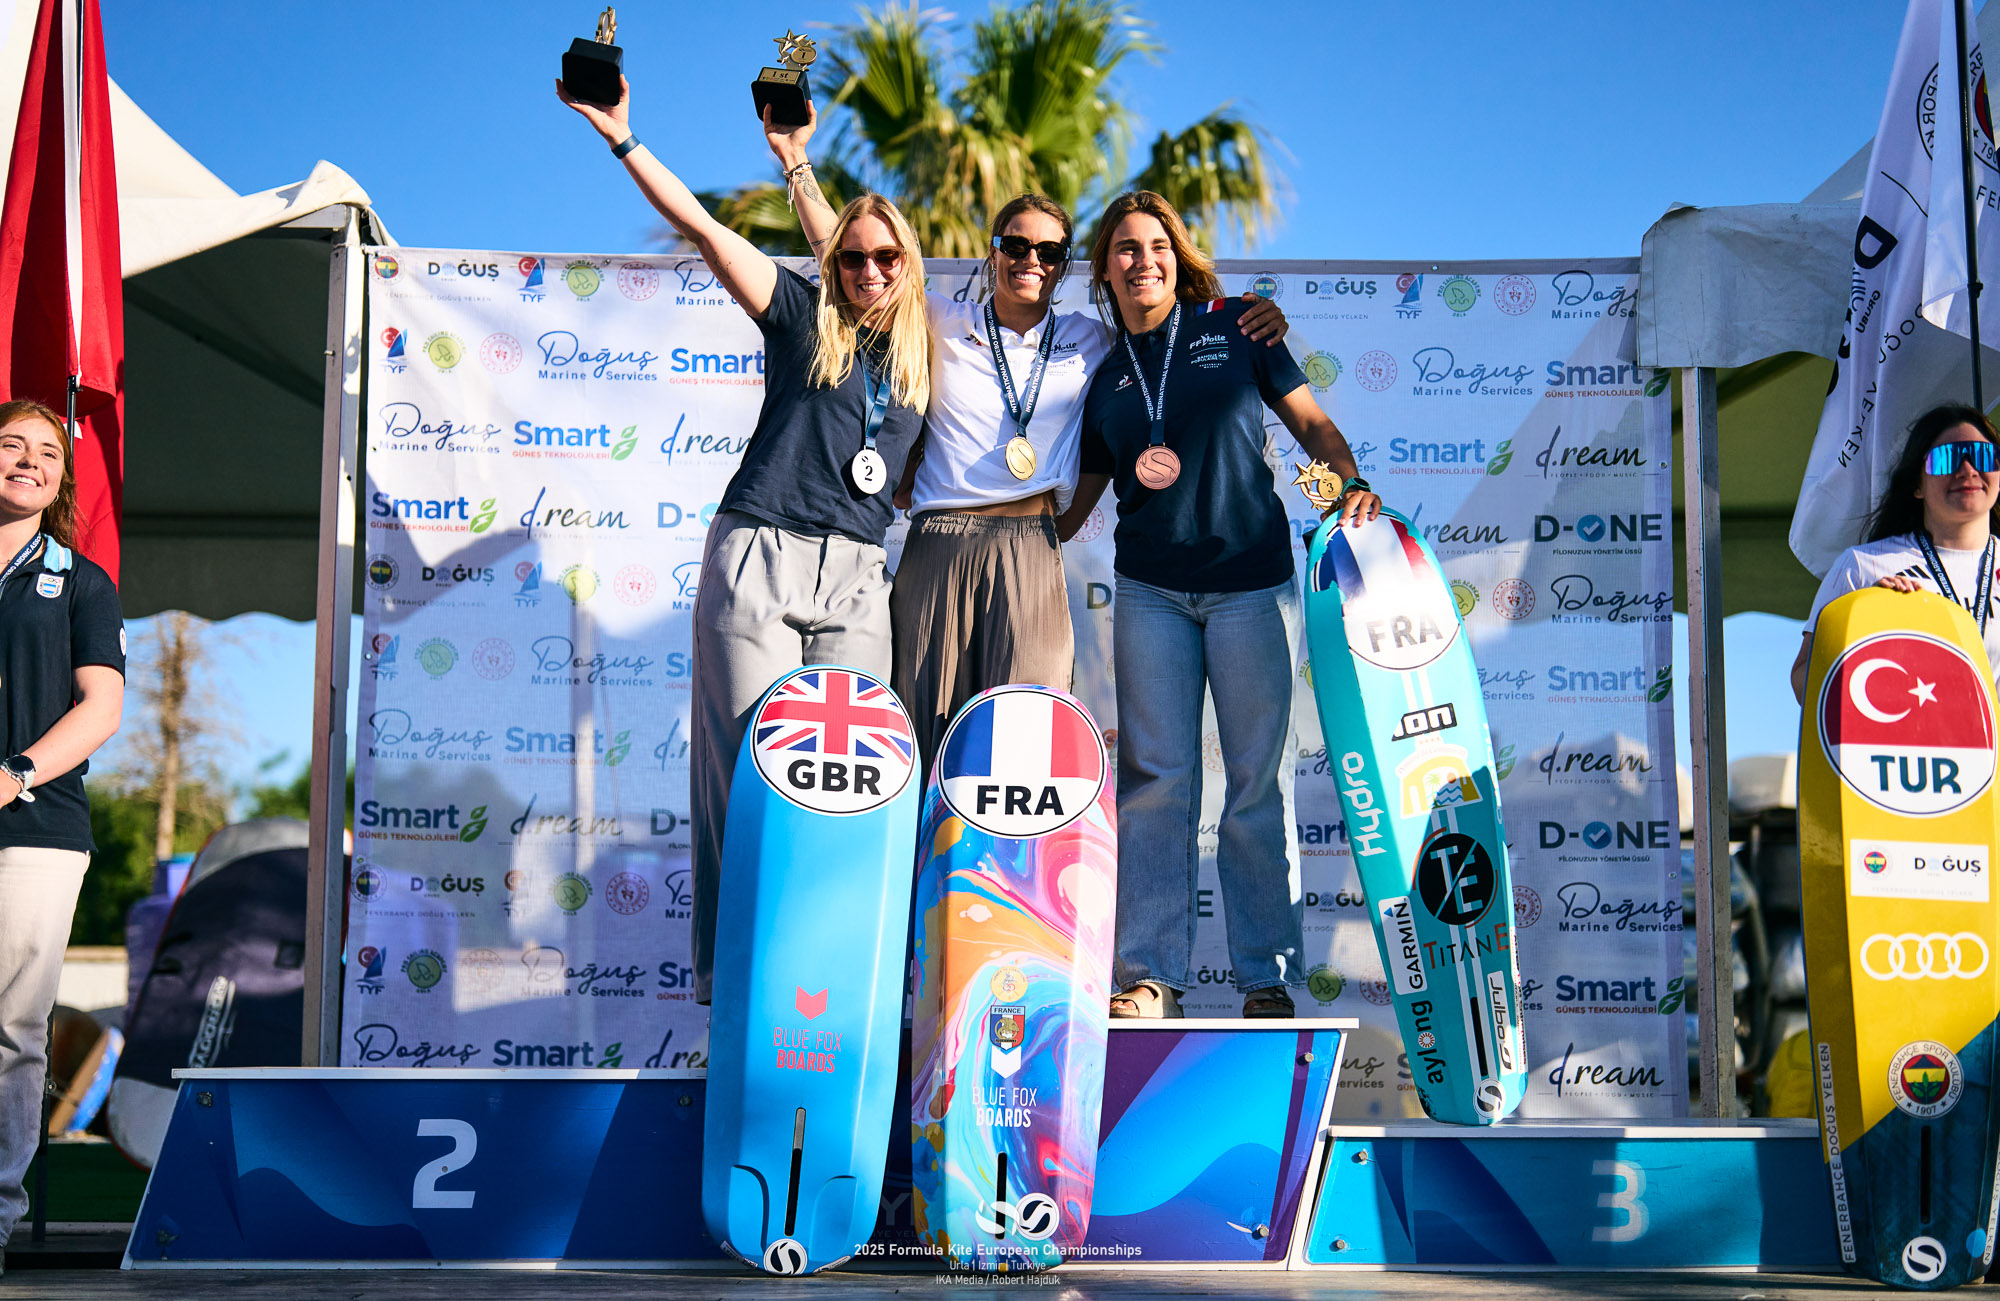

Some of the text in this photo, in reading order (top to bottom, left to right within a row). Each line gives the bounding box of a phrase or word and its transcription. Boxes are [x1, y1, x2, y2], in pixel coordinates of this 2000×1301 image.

[428, 259, 500, 282] DOĞUŞ
[519, 293, 547, 303] TYF
[1305, 277, 1378, 300] DOĞUŞ
[676, 296, 724, 306] Marine
[1286, 313, 1310, 321] BAHÇE
[1395, 310, 1422, 319] TYF
[1552, 309, 1601, 319] Marine
[538, 330, 659, 379] Doğuş
[671, 348, 765, 375] Smart
[538, 370, 658, 381] Marine Services
[669, 377, 765, 386] GÜNEŞ TEKNOLOJİLER
[1412, 347, 1535, 394] Doğuş
[1546, 360, 1643, 386] Smart
[1413, 386, 1533, 396] Marine Services
[1545, 388, 1643, 399] GÜNEŞ TEKNOLOJİLERİ
[513, 420, 611, 447] Smart
[448, 443, 500, 454] Services
[512, 451, 541, 459] GÜNEŞ
[1389, 437, 1486, 464] Smart
[864, 465, 873, 482] 2
[1388, 467, 1486, 476] GÜNEŞ TEKNOLOJİLERİ
[1326, 481, 1335, 493] 3
[371, 491, 469, 520] Smart
[370, 521, 469, 533] GÜNEŞ TEKNOLOJİLERİ
[1534, 513, 1663, 543] D-ONE
[422, 564, 495, 587] DOĞUŞ
[514, 598, 541, 608] TYF
[1551, 574, 1674, 622] Doğuş
[1552, 613, 1673, 624] Marine Services
[1367, 614, 1443, 653] FRA
[531, 635, 654, 684] Doğuş
[371, 670, 399, 681] TYF
[531, 675, 653, 687] Marine Services
[1547, 665, 1646, 692] Smart
[1482, 690, 1535, 701] Services
[368, 708, 493, 759] Doğuş
[368, 748, 491, 761] Marine Services
[787, 758, 882, 796] GBR
[1870, 755, 1962, 795] TUR
[976, 784, 1064, 816] FRA
[1341, 751, 1388, 857] Hydro
[360, 800, 460, 829] Smart
[358, 831, 459, 842] GÜNEŞ TEKNOLOJİLERİ
[1539, 820, 1671, 850] D-ONE
[1299, 847, 1350, 857] NOLOJİLERİ
[1914, 855, 1981, 877] DOĞUŞ
[410, 873, 485, 897] DOĞUŞ
[1306, 888, 1366, 907] DOĞU
[1557, 881, 1683, 931] Doğuş
[1559, 922, 1684, 932] Marine Services
[1393, 900, 1424, 990] GARMIN
[357, 984, 385, 996] TYF
[591, 987, 645, 998] Services
[1556, 974, 1657, 1002] Smart
[1555, 1005, 1657, 1015] GÜNEŞ TEKNOLOJİLERİ
[773, 1027, 844, 1052] BLUE FOX
[493, 1038, 595, 1067] Smart
[776, 1049, 836, 1073] BOARDS
[1890, 1044, 1920, 1101] FENERBAHÇE
[1923, 1043, 1949, 1060] SPOR
[1337, 1078, 1384, 1089] ervices
[972, 1086, 1038, 1107] BLUE FOX
[975, 1107, 1032, 1128] BOARDS
[1915, 1105, 1937, 1115] 1907
[413, 1119, 478, 1209] 2
[1820, 1044, 1855, 1263] FENERBAHÇE DOĞUŞ YELKEN
[1591, 1160, 1650, 1242] 3
